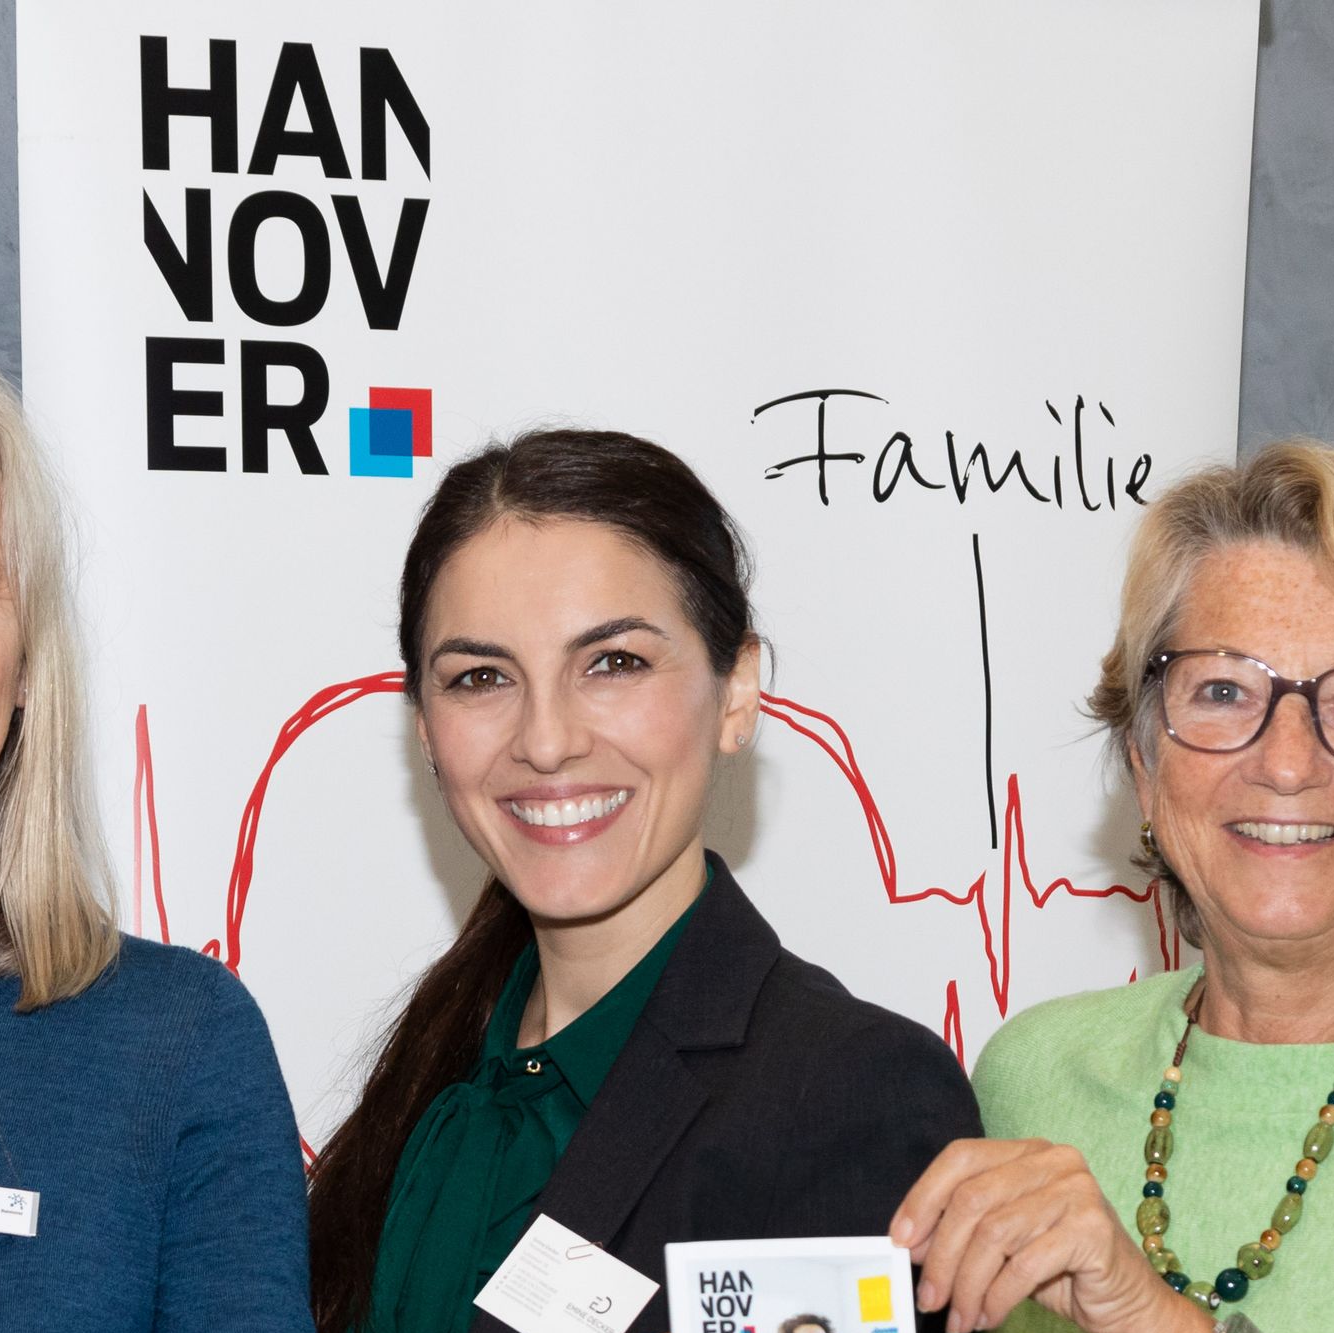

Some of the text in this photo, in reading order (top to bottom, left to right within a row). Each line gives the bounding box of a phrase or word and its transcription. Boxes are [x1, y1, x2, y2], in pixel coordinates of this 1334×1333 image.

[140, 36, 430, 181] HAN
[143, 186, 430, 330] NOV
[146, 337, 329, 475] ER
[751, 389, 1153, 511] Familie
[699, 1270, 753, 1294] HAN
[701, 1294, 752, 1318] NOV
